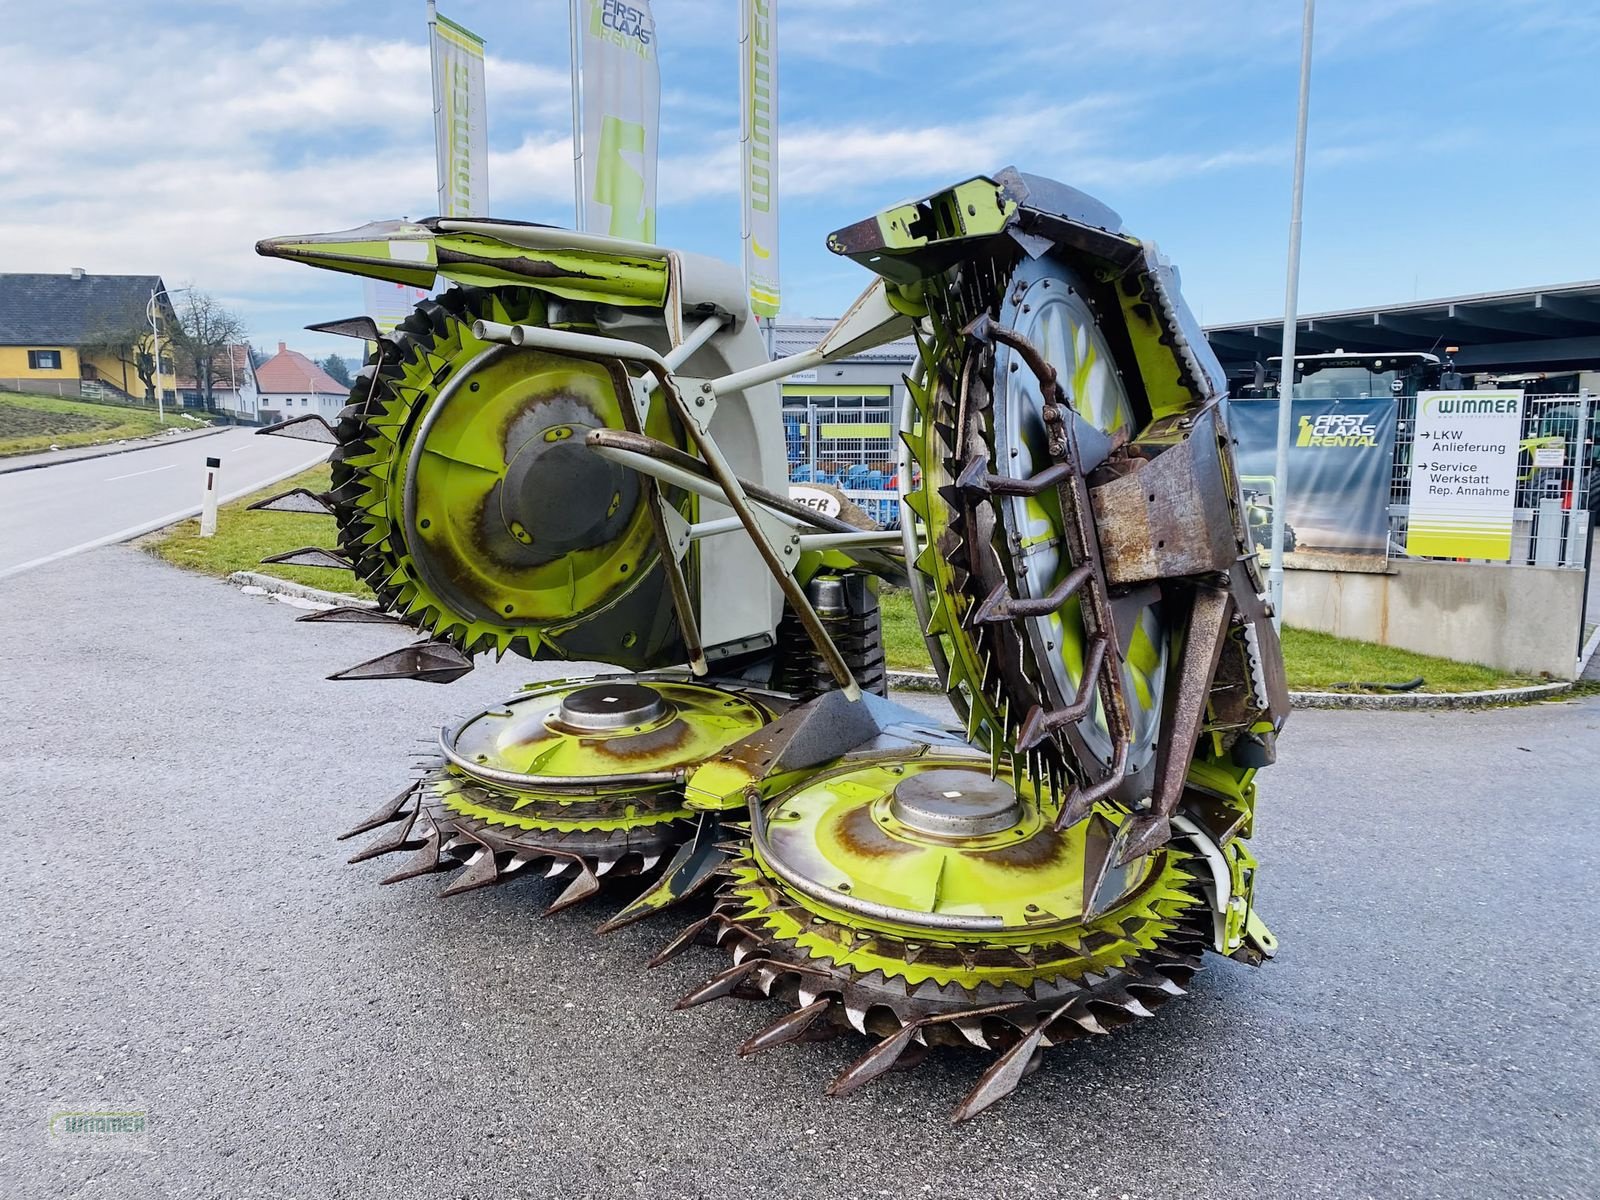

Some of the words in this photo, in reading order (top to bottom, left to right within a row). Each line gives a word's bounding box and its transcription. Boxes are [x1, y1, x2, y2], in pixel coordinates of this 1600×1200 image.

[603, 0, 645, 25] FIRST
[602, 11, 652, 45] CLAAS
[454, 61, 470, 217] IMMER
[1438, 400, 1518, 413] WIMMER
[1314, 414, 1369, 426] FIRST
[1312, 425, 1377, 436] CLAAS
[1433, 430, 1463, 440] LKW
[1308, 435, 1379, 447] RENTAL
[1432, 442, 1506, 455] Anlieferung
[1430, 462, 1478, 472] Service
[1430, 474, 1489, 484] Werkstatt
[1429, 485, 1453, 496] Rep.
[1456, 486, 1510, 497] Annahme
